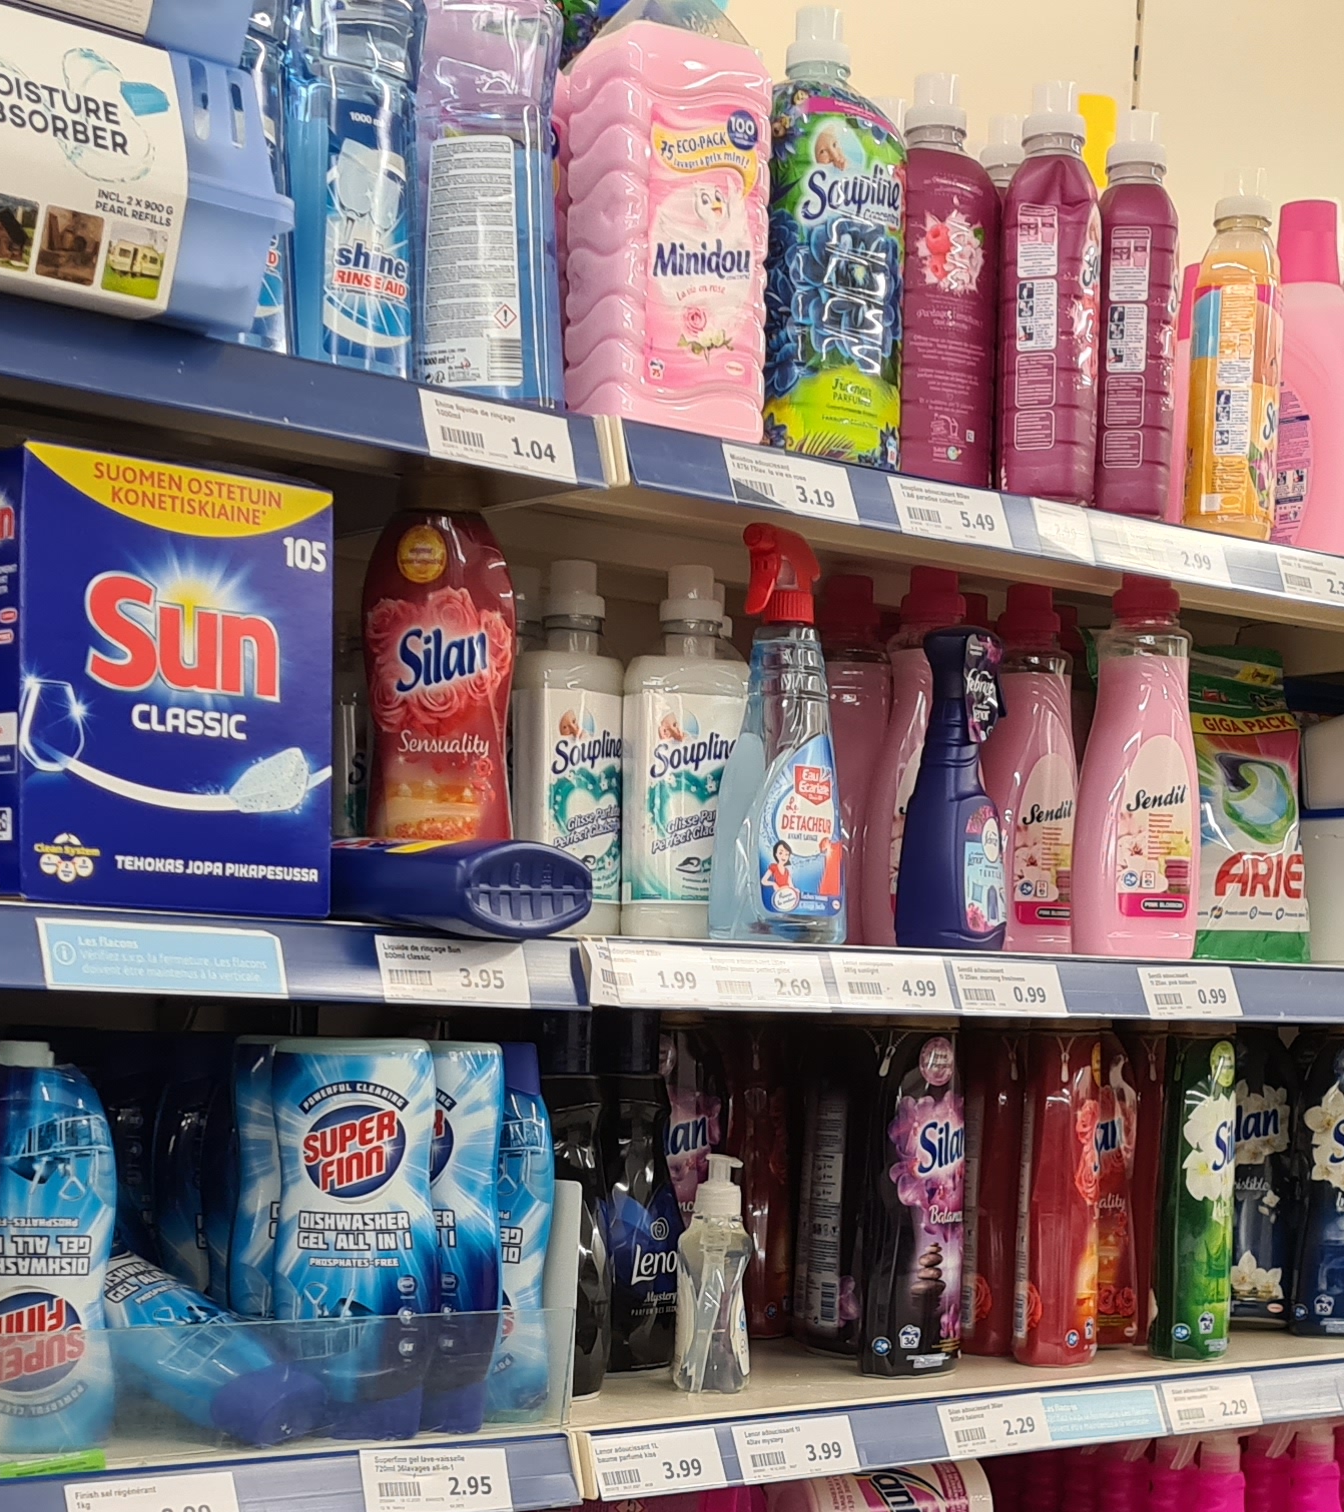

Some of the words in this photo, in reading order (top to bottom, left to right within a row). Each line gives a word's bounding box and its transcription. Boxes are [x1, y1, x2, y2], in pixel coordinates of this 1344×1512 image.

[95, 201, 129, 218] PEARL
[131, 211, 171, 227] REFILLS
[98, 188, 124, 203] INCL.
[127, 196, 133, 206] 2
[136, 198, 143, 208] X
[144, 200, 164, 213] 900
[166, 205, 174, 215] G
[335, 239, 408, 280] shine
[653, 239, 751, 279] Minidou
[334, 268, 382, 290] RINSE
[383, 277, 406, 298] AID
[511, 436, 556, 463] 1.04
[796, 485, 836, 508] 3.19
[960, 510, 995, 532] 5.49
[283, 537, 327, 573] 105
[85, 570, 281, 702] Sun
[395, 627, 488, 694] Silan
[131, 704, 248, 740] CLASSIC
[1202, 714, 1241, 735] GIGA
[1243, 713, 1293, 733] PACK
[396, 730, 490, 757] Sensuality
[552, 736, 622, 774] Soupline
[1126, 784, 1187, 813] Sendil
[458, 967, 505, 990] 3.95
[657, 970, 697, 991] 1.99
[774, 977, 812, 997] 2.69
[301, 1082, 353, 1114] POWERFUL
[355, 1081, 409, 1113] CLEANING
[302, 1108, 398, 1166] SUPER
[320, 1144, 386, 1192] FINN
[298, 1211, 411, 1232] DISHWASHER
[298, 1231, 329, 1250] GEL
[334, 1231, 365, 1250] ALL
[375, 1231, 397, 1250] IN
[308, 1257, 399, 1268] PHOSPHATES-FREE
[1003, 1417, 1036, 1436] 2.29
[662, 1458, 702, 1480] 3.99
[448, 1475, 493, 1497] 2.95
